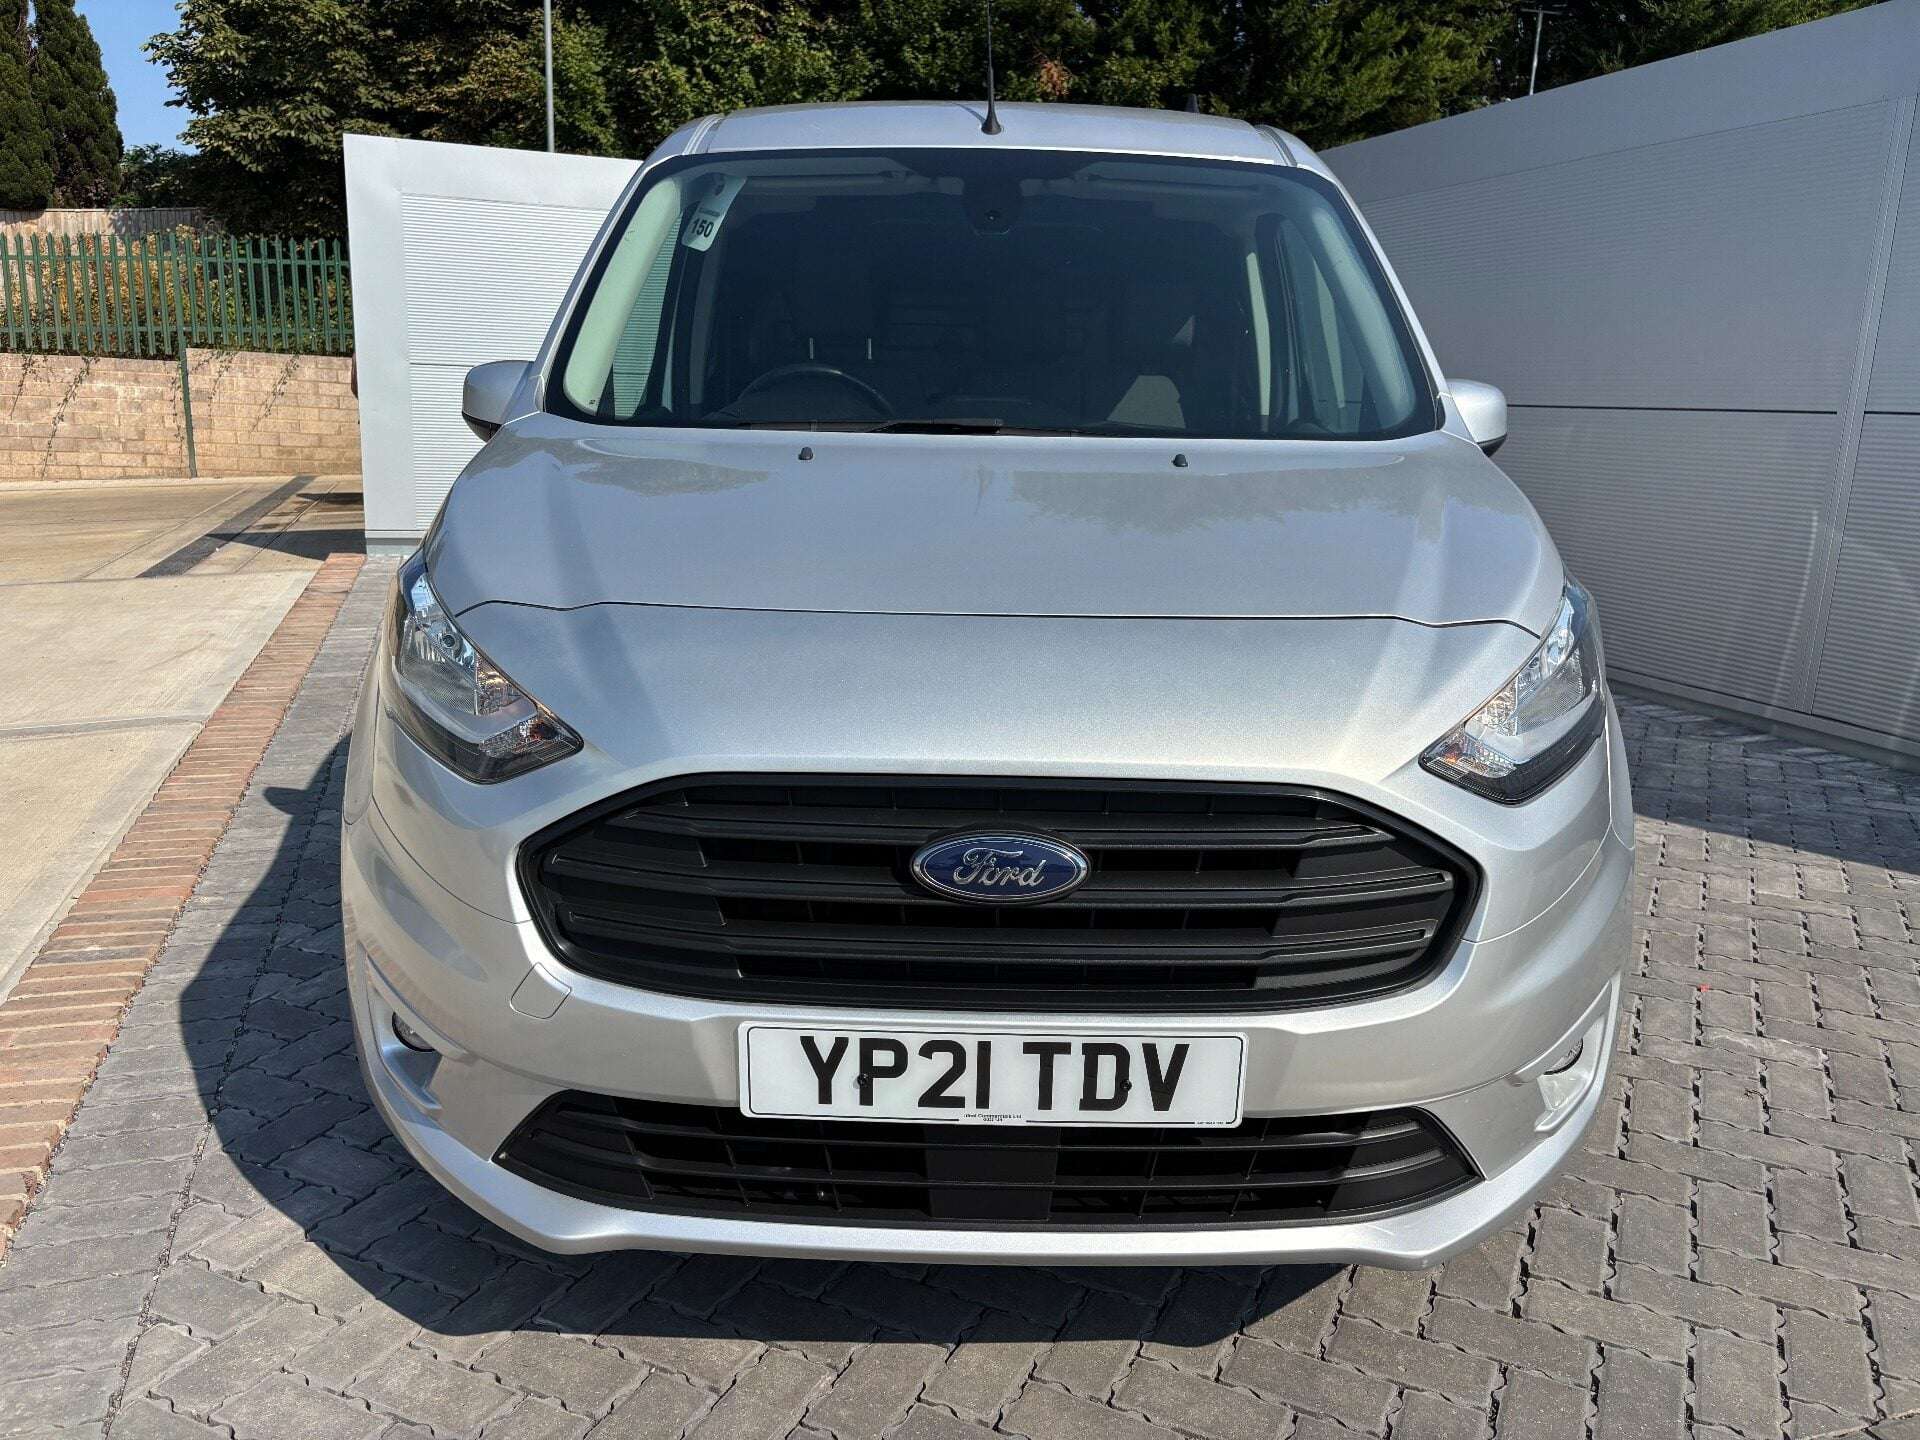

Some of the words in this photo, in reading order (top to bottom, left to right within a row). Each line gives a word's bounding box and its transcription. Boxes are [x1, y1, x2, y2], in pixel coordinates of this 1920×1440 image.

[691, 218, 714, 238] 150
[953, 847, 1047, 887] Ford
[799, 1036, 992, 1110] YP21
[1022, 1042, 1191, 1112] TDV
